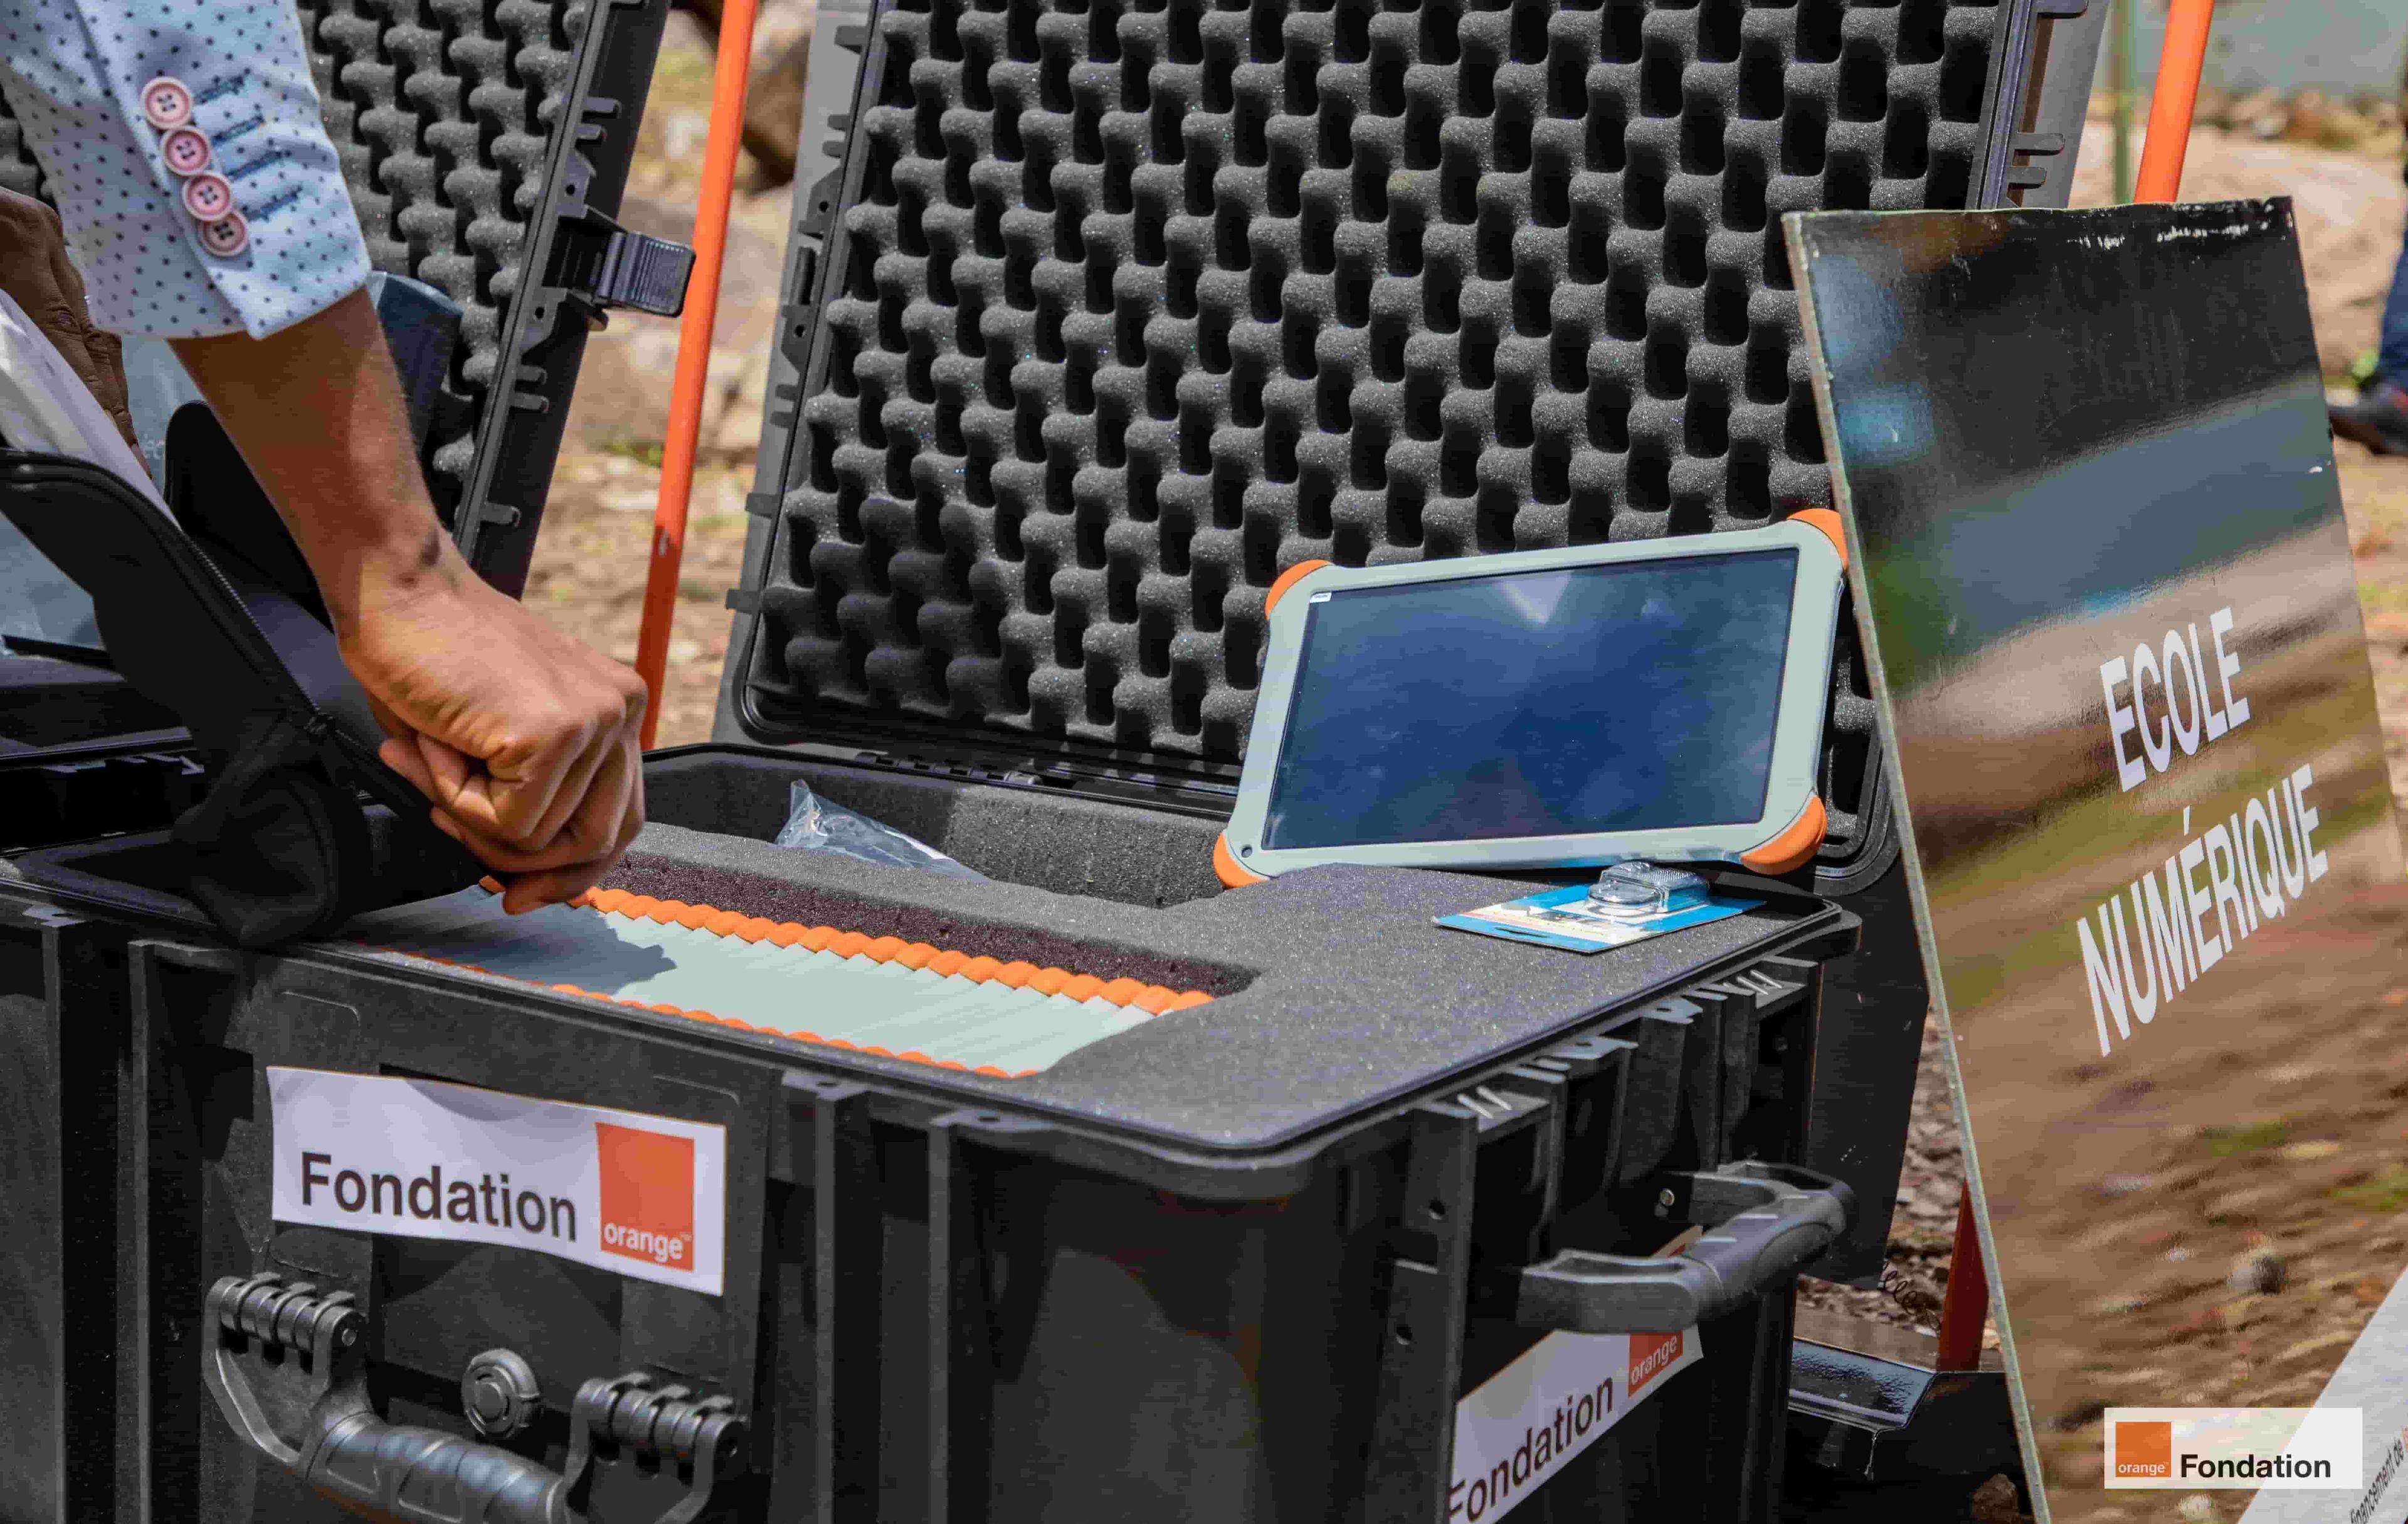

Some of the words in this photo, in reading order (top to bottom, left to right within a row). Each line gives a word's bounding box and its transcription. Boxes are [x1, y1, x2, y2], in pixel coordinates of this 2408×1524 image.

[2099, 606, 2251, 792] ECOLE
[2076, 762, 2329, 1058] NUMÉRIQUE
[301, 1151, 576, 1242] Fondation
[603, 1222, 684, 1263] orange
[1630, 1335, 1678, 1385] orange
[1446, 1376, 1613, 1524] Fondation
